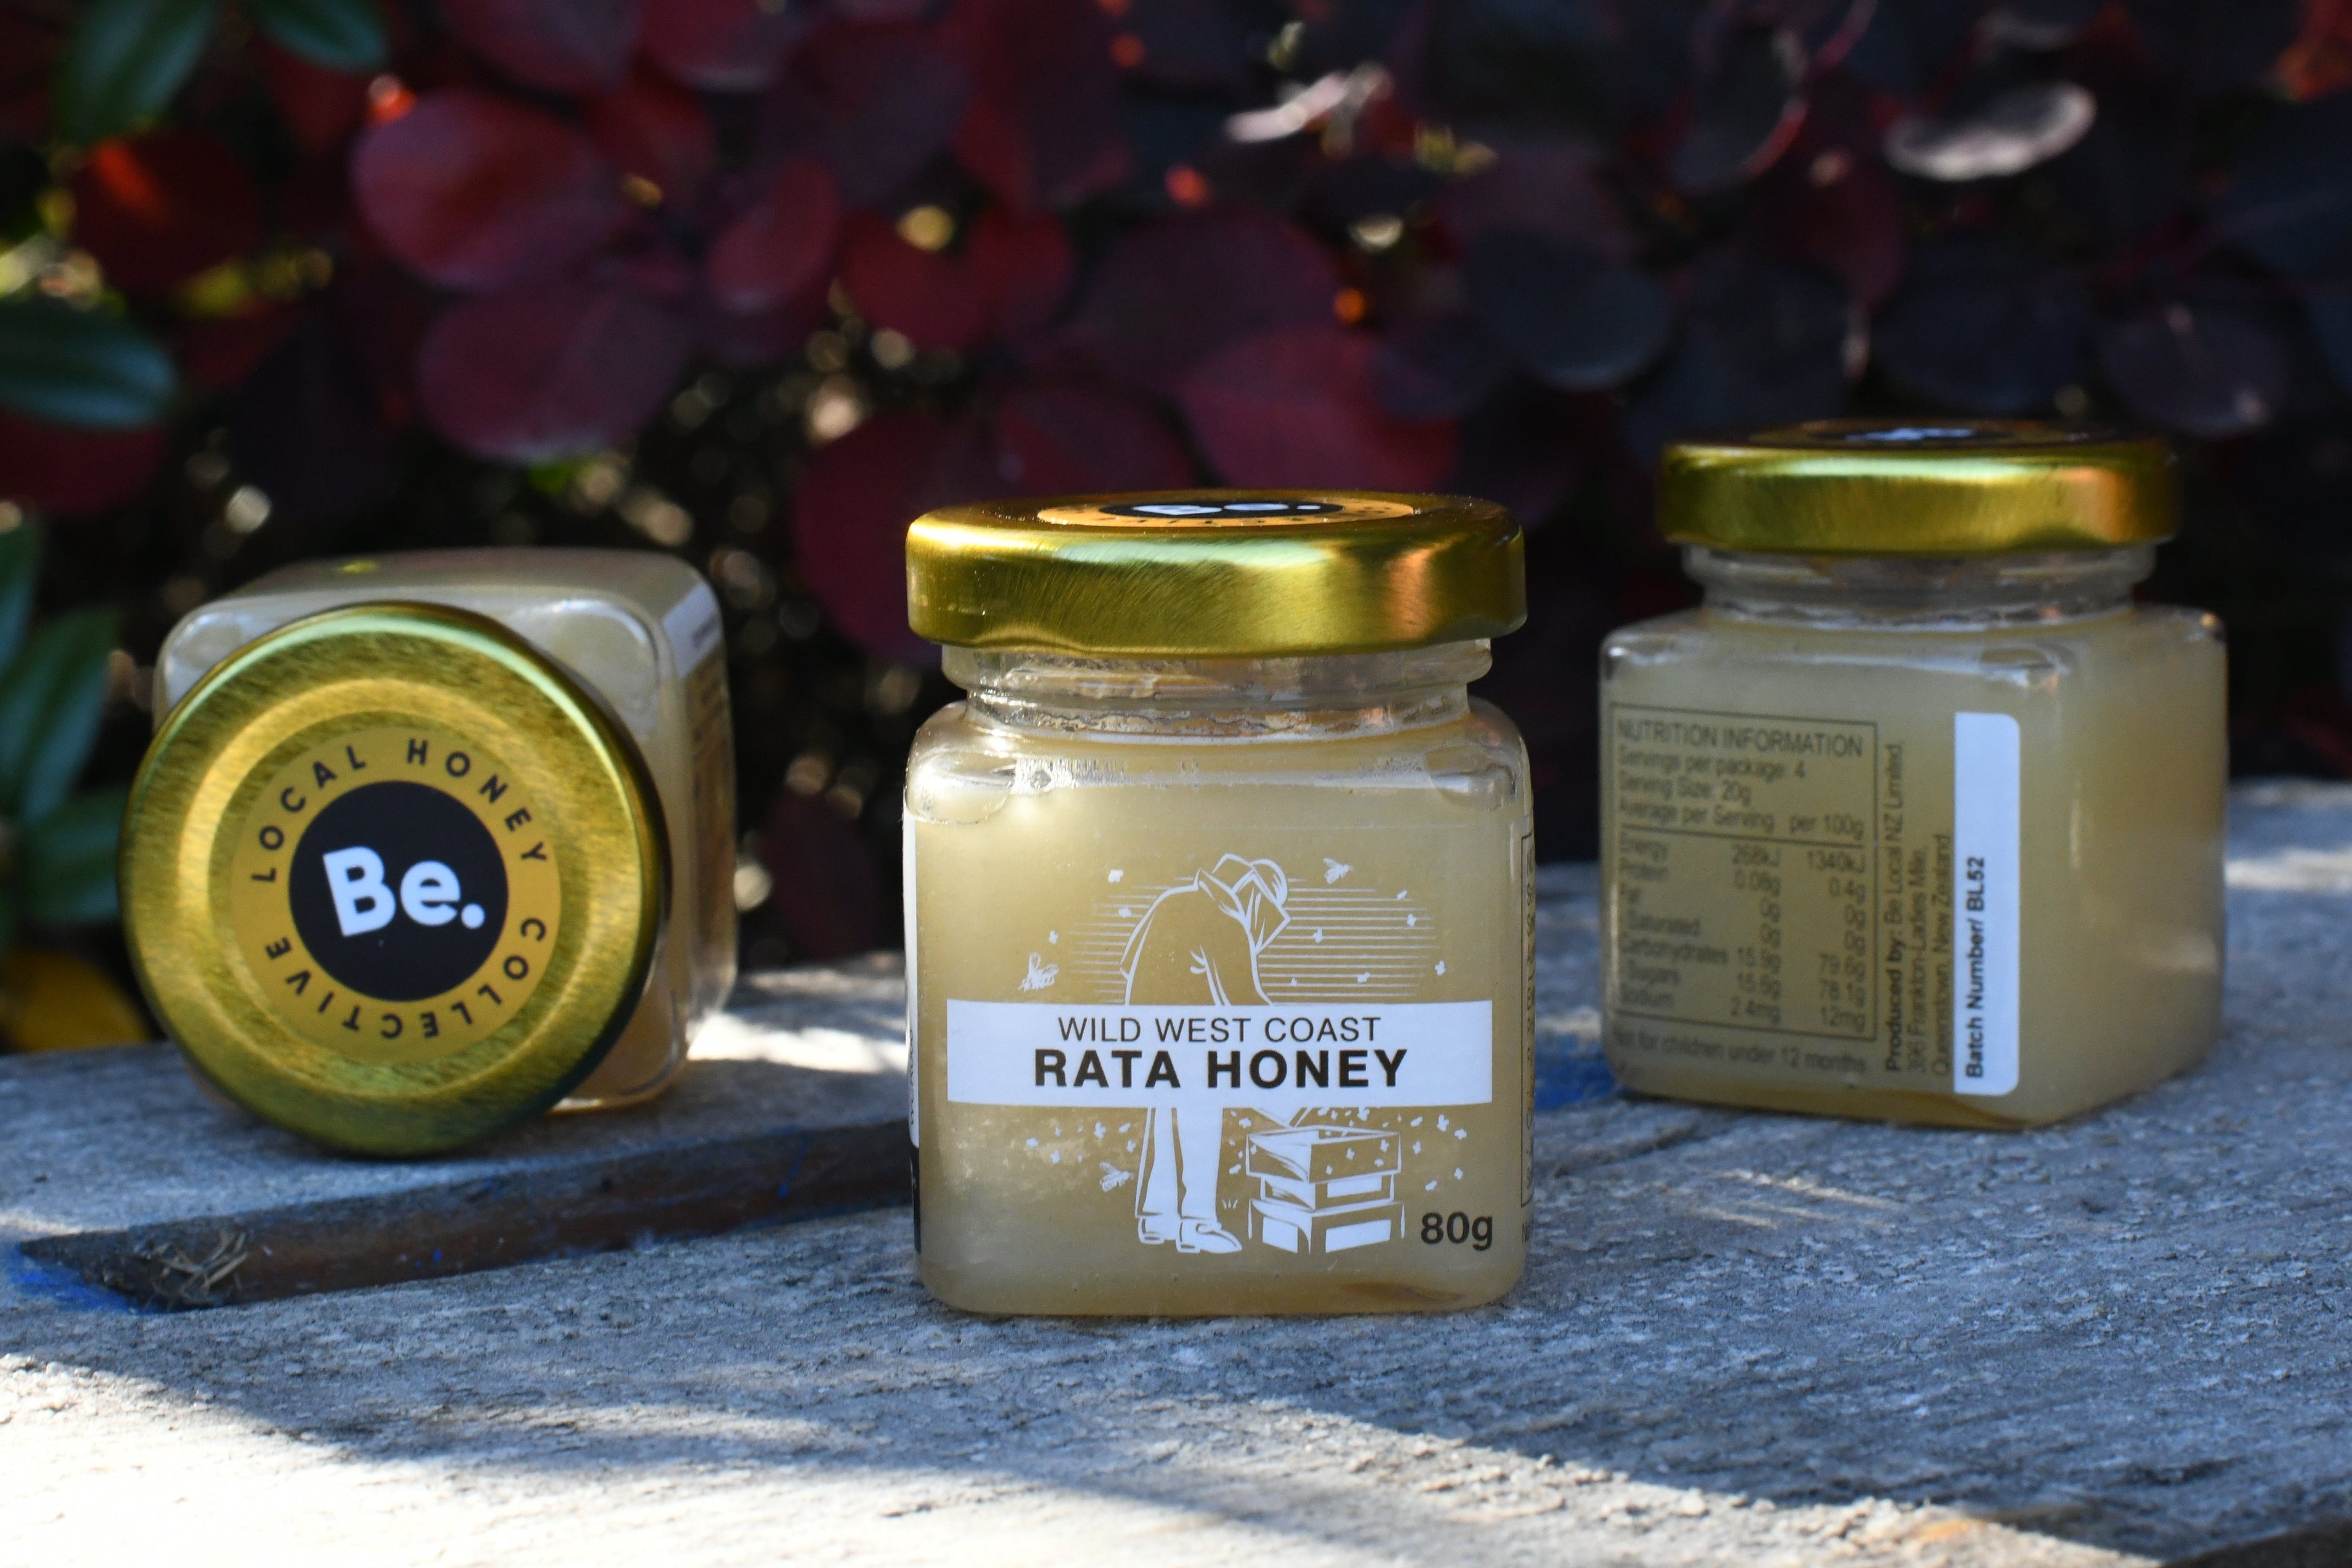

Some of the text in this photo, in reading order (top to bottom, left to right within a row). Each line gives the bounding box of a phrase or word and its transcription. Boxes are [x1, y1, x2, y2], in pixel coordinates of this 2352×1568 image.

[1618, 719, 1863, 758] NUTRITION INFORMATION
[1686, 755, 1710, 774] per
[1794, 761, 1805, 778] 4
[1721, 779, 1752, 807] 20g
[1714, 808, 1775, 834] Serving
[1789, 816, 1817, 834] per
[1824, 815, 1864, 841] 100g
[1884, 813, 1902, 842] NZ
[252, 739, 547, 1039] LOCAL HONEY COLLECTIVE
[1884, 846, 1902, 894] Local
[1966, 857, 1984, 911] BL52
[322, 847, 485, 937] Be.
[1884, 899, 1902, 925] Be
[1058, 1016, 1381, 1043] WILD WEST COAST
[1884, 968, 1903, 1073] Produced
[1781, 1046, 1800, 1068] 12
[1965, 1016, 1984, 1077] Batch
[1034, 1048, 1408, 1090] RATA HONEY
[1420, 1212, 1494, 1252] 80g
